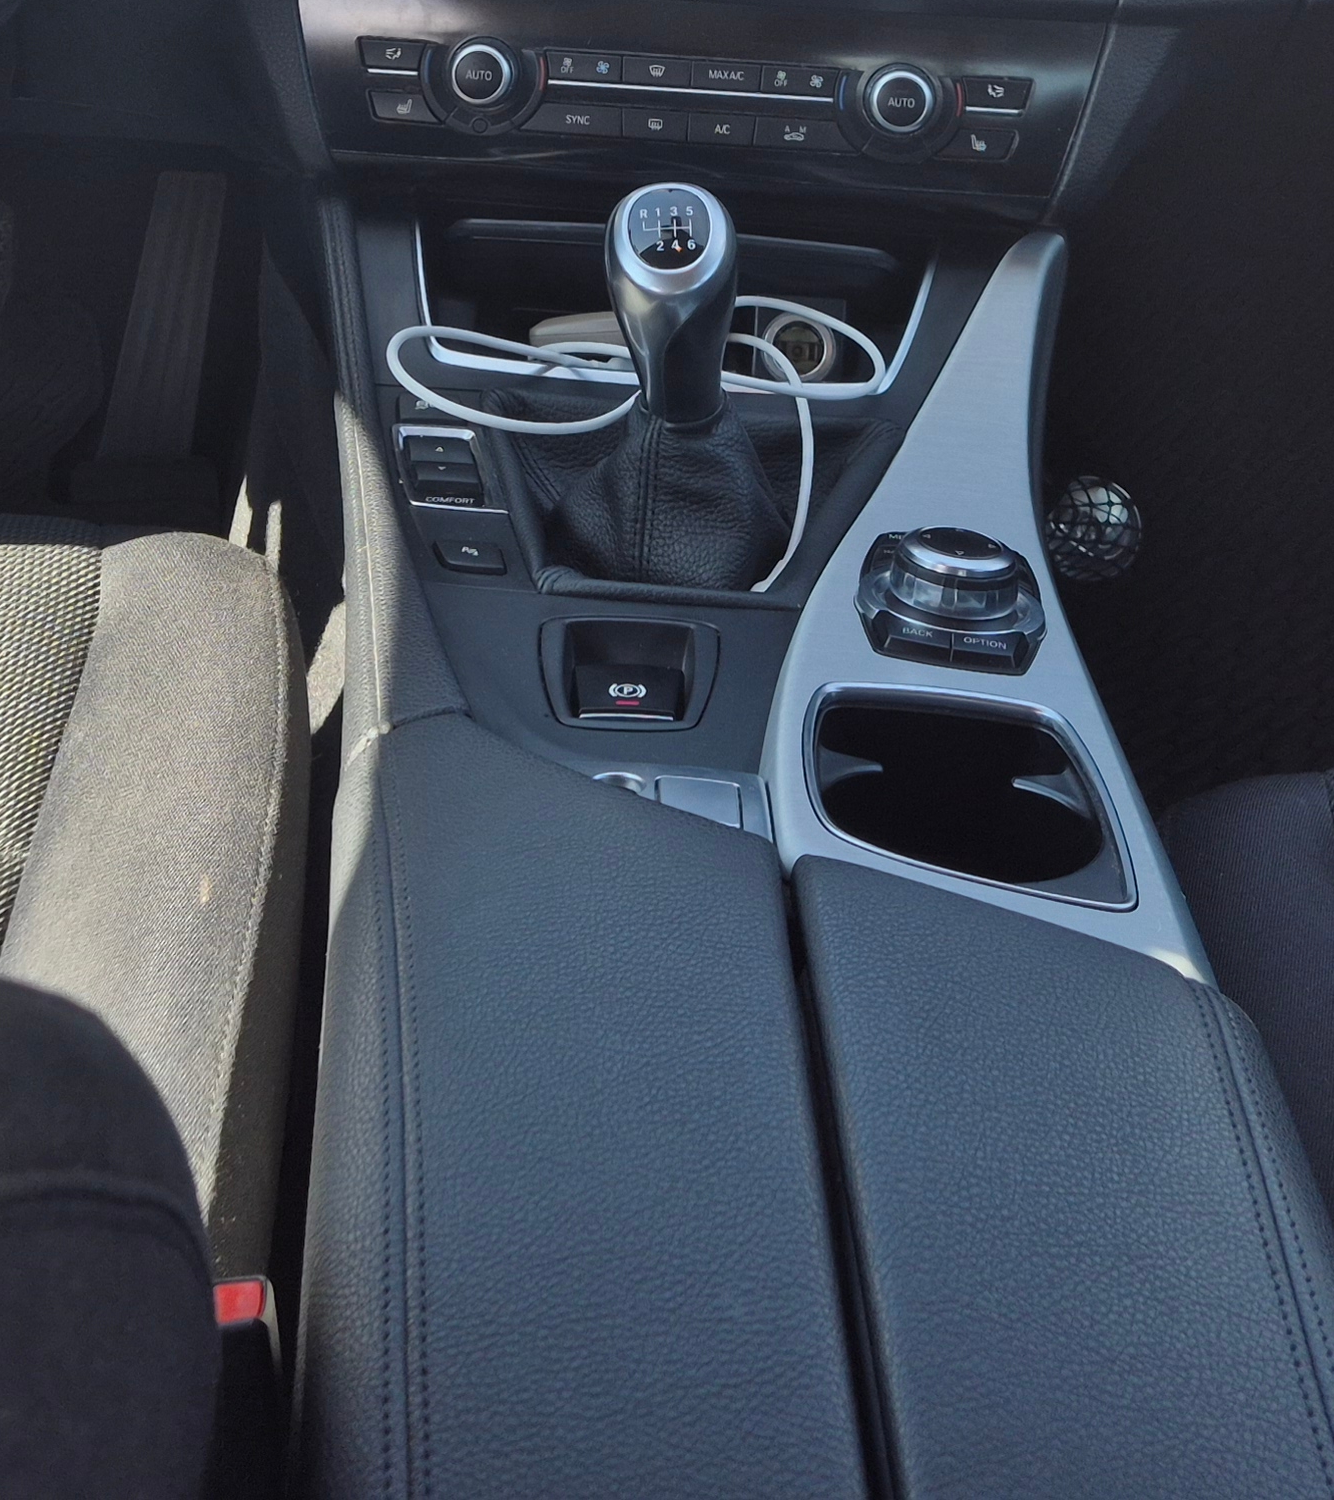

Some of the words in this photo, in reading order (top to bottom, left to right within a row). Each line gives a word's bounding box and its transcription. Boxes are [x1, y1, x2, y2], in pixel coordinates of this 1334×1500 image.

[465, 69, 493, 81] AUTO
[560, 65, 574, 74] OFF
[774, 79, 788, 87] OFF
[887, 97, 915, 109] AUTO
[565, 115, 591, 126] SYNC
[714, 124, 731, 135] A/C
[639, 208, 648, 219] R
[654, 206, 660, 217] 1
[669, 206, 678, 217] 3
[685, 206, 694, 216] 5
[656, 240, 665, 251] 2
[671, 239, 680, 251] 4
[687, 239, 696, 250] 6
[425, 496, 475, 504] COMFORT
[902, 626, 934, 638] BACK
[963, 636, 1007, 650] OPTION
